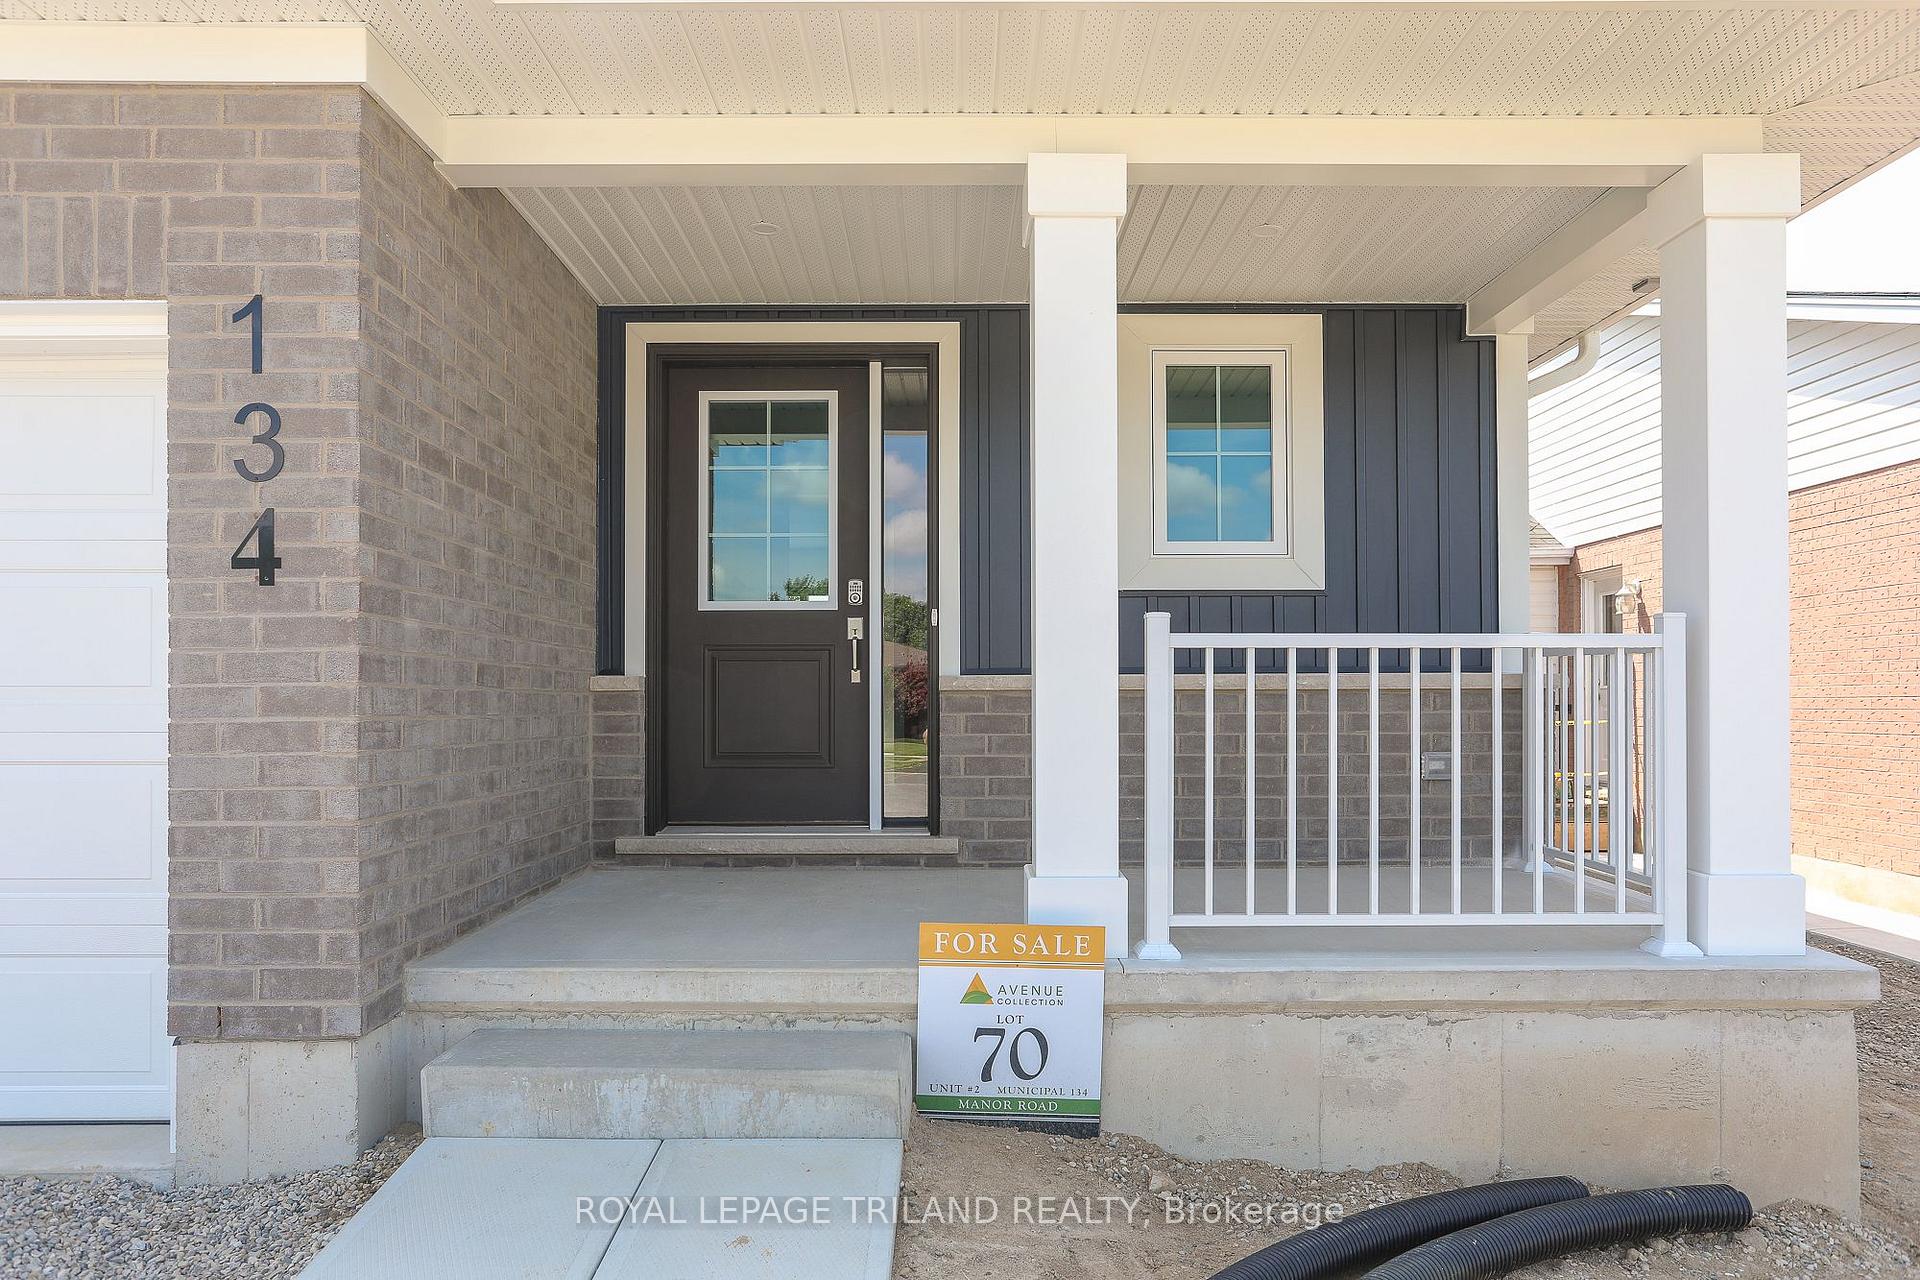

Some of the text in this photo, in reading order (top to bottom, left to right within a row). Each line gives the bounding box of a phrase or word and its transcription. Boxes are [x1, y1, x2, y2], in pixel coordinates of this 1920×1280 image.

[934, 931, 1091, 956] FOR SALE
[997, 984, 1063, 997] AVENUE
[997, 998, 1064, 1006] COLLECTION
[997, 1015, 1024, 1024] LOT
[973, 1027, 1049, 1082] 70
[929, 1083, 1088, 1097] UNIT #2 MUNICIPAL 134
[958, 1099, 1058, 1112] MANOR ROAD
